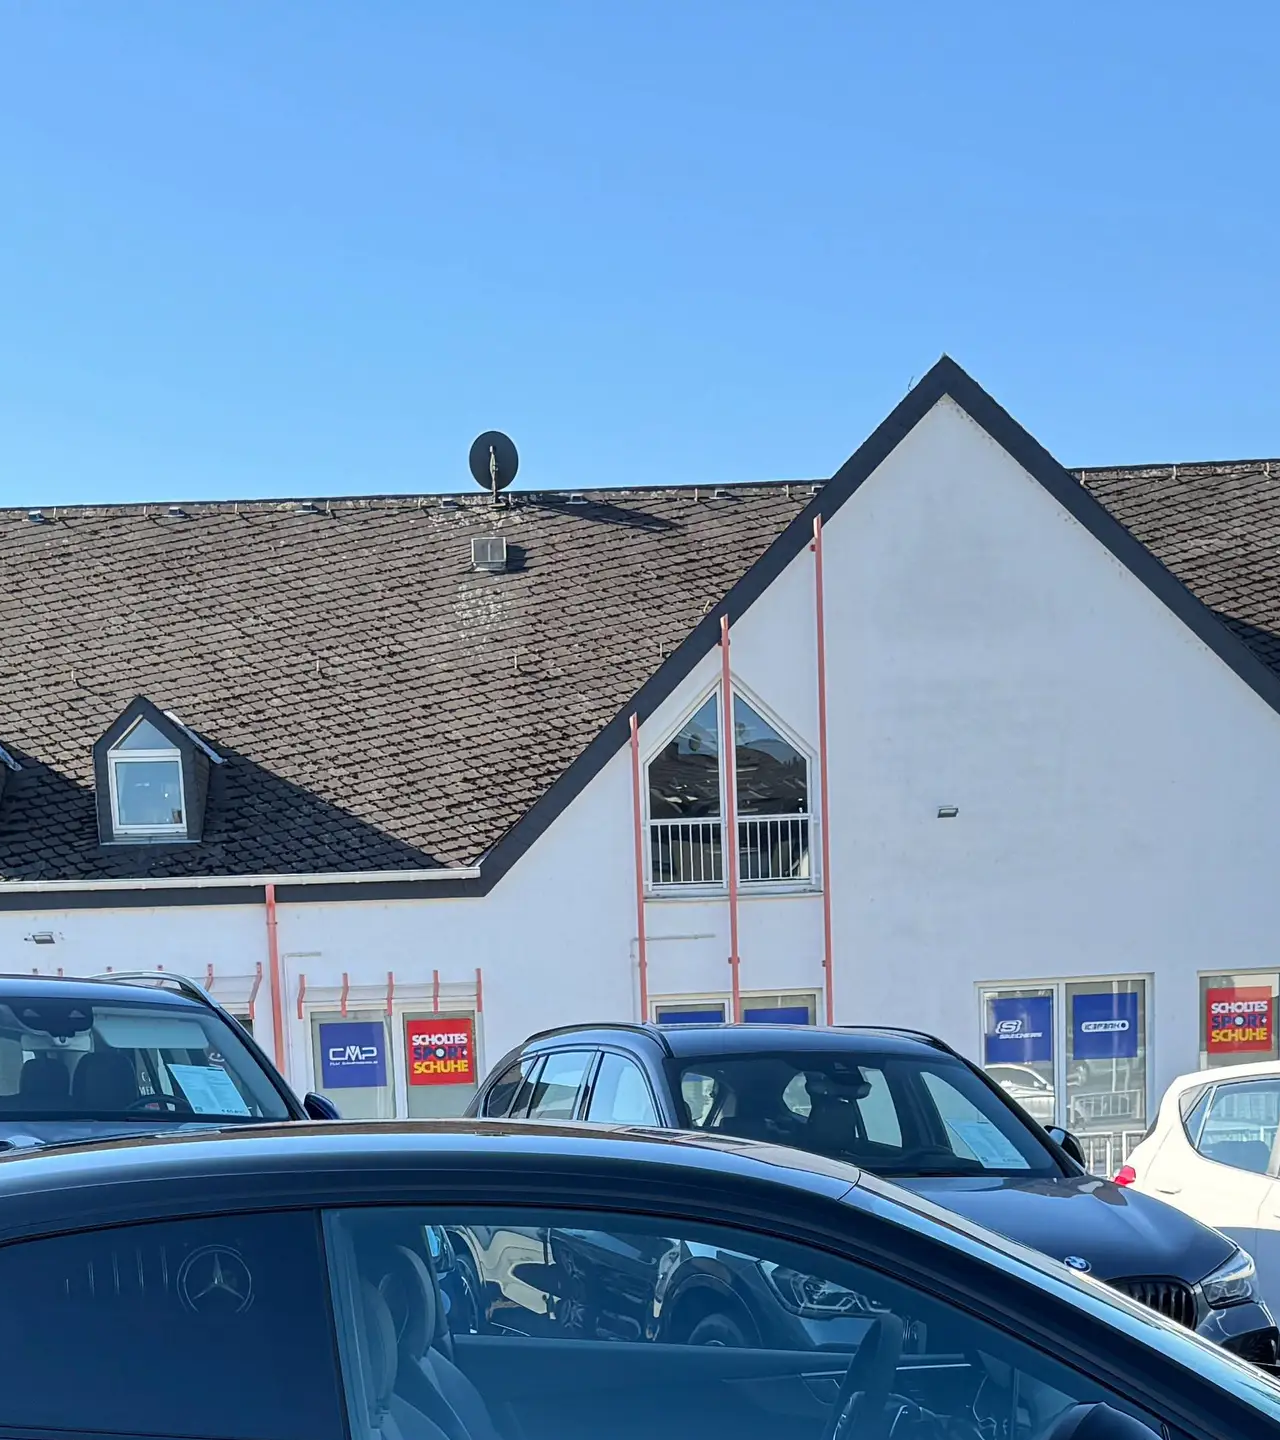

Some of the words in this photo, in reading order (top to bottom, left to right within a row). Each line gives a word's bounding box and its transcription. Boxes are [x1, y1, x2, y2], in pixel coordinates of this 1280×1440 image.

[1211, 1000, 1268, 1014] SCHOLTES
[412, 1033, 468, 1046] SCHOLTES
[1211, 1028, 1268, 1042] SCHUHE
[329, 1045, 378, 1062] CMP
[413, 1060, 469, 1074] SCHUHE
